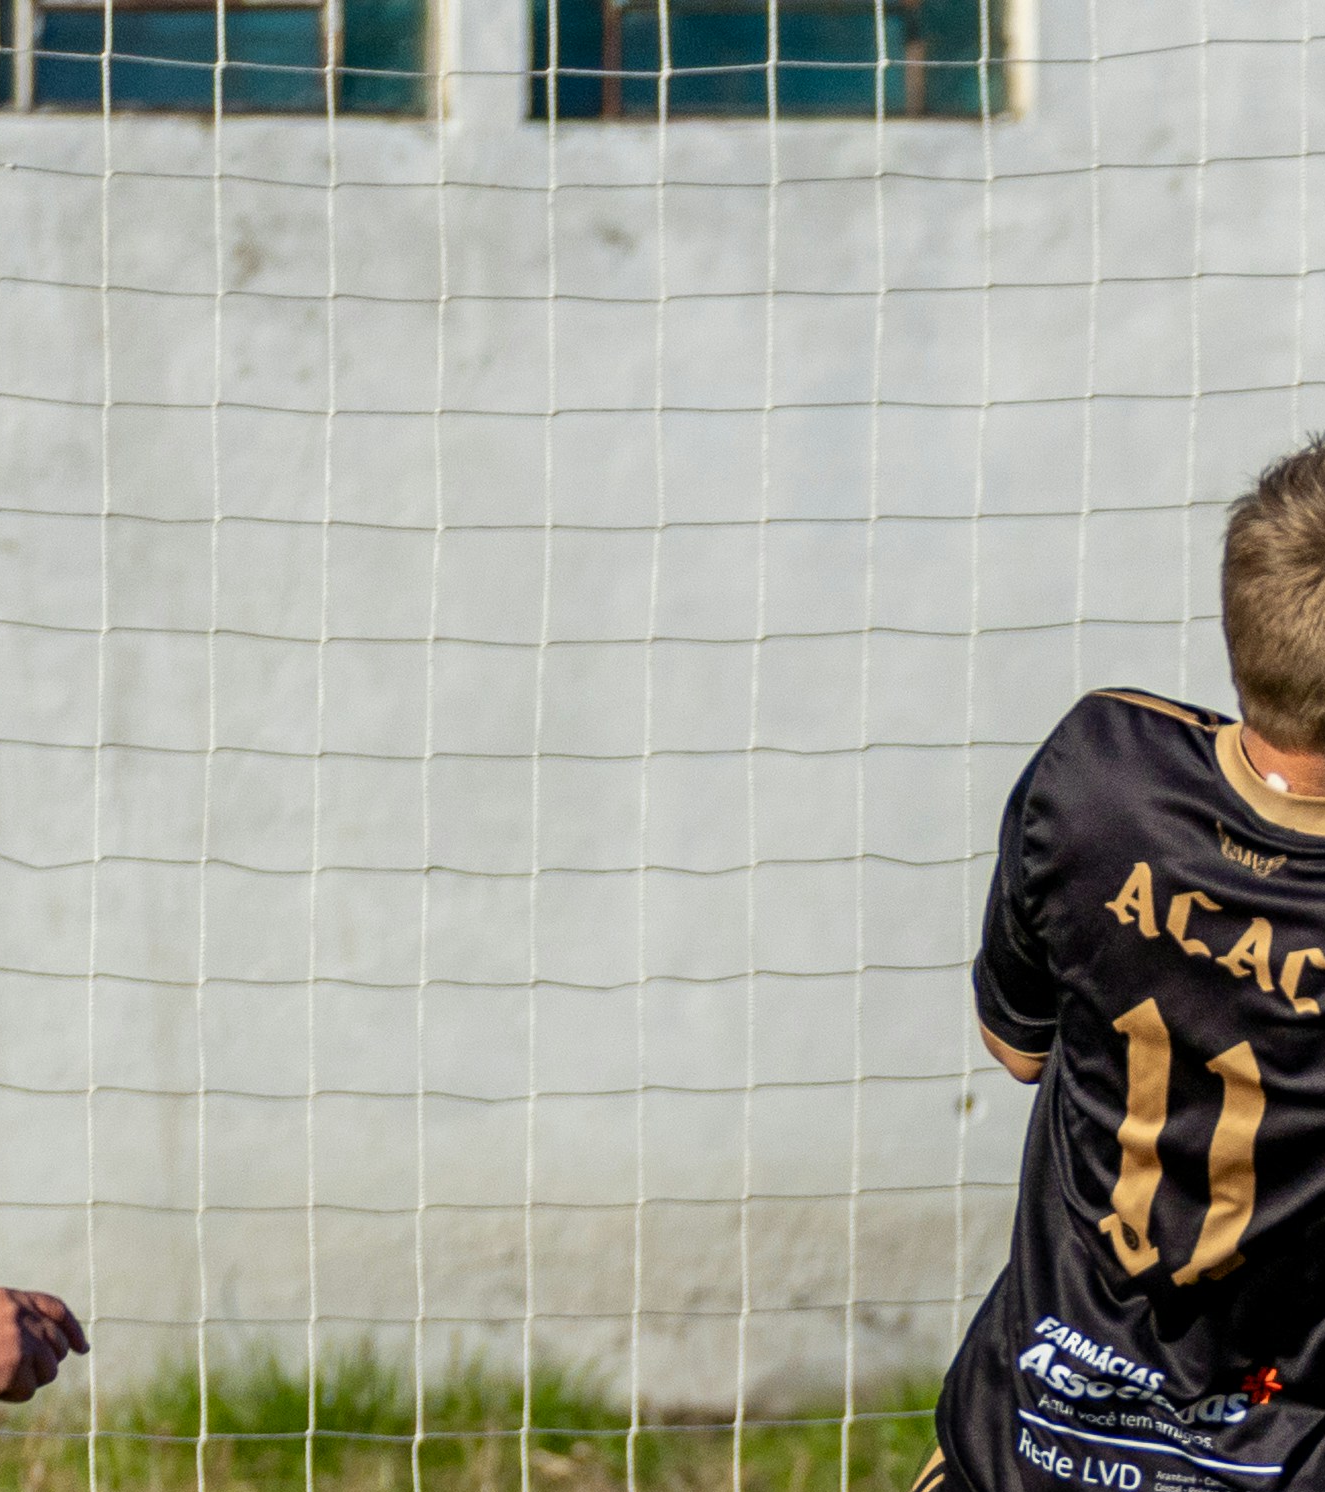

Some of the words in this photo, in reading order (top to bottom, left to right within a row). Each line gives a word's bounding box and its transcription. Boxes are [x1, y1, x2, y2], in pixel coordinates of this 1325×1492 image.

[1098, 998, 1266, 1287] 11
[1035, 1316, 1166, 1392] FARMÁCIAS
[1077, 1411, 1118, 1427] você
[1120, 1412, 1153, 1430] tem
[1019, 1427, 1074, 1479] Rede
[1081, 1456, 1142, 1491] LVD
